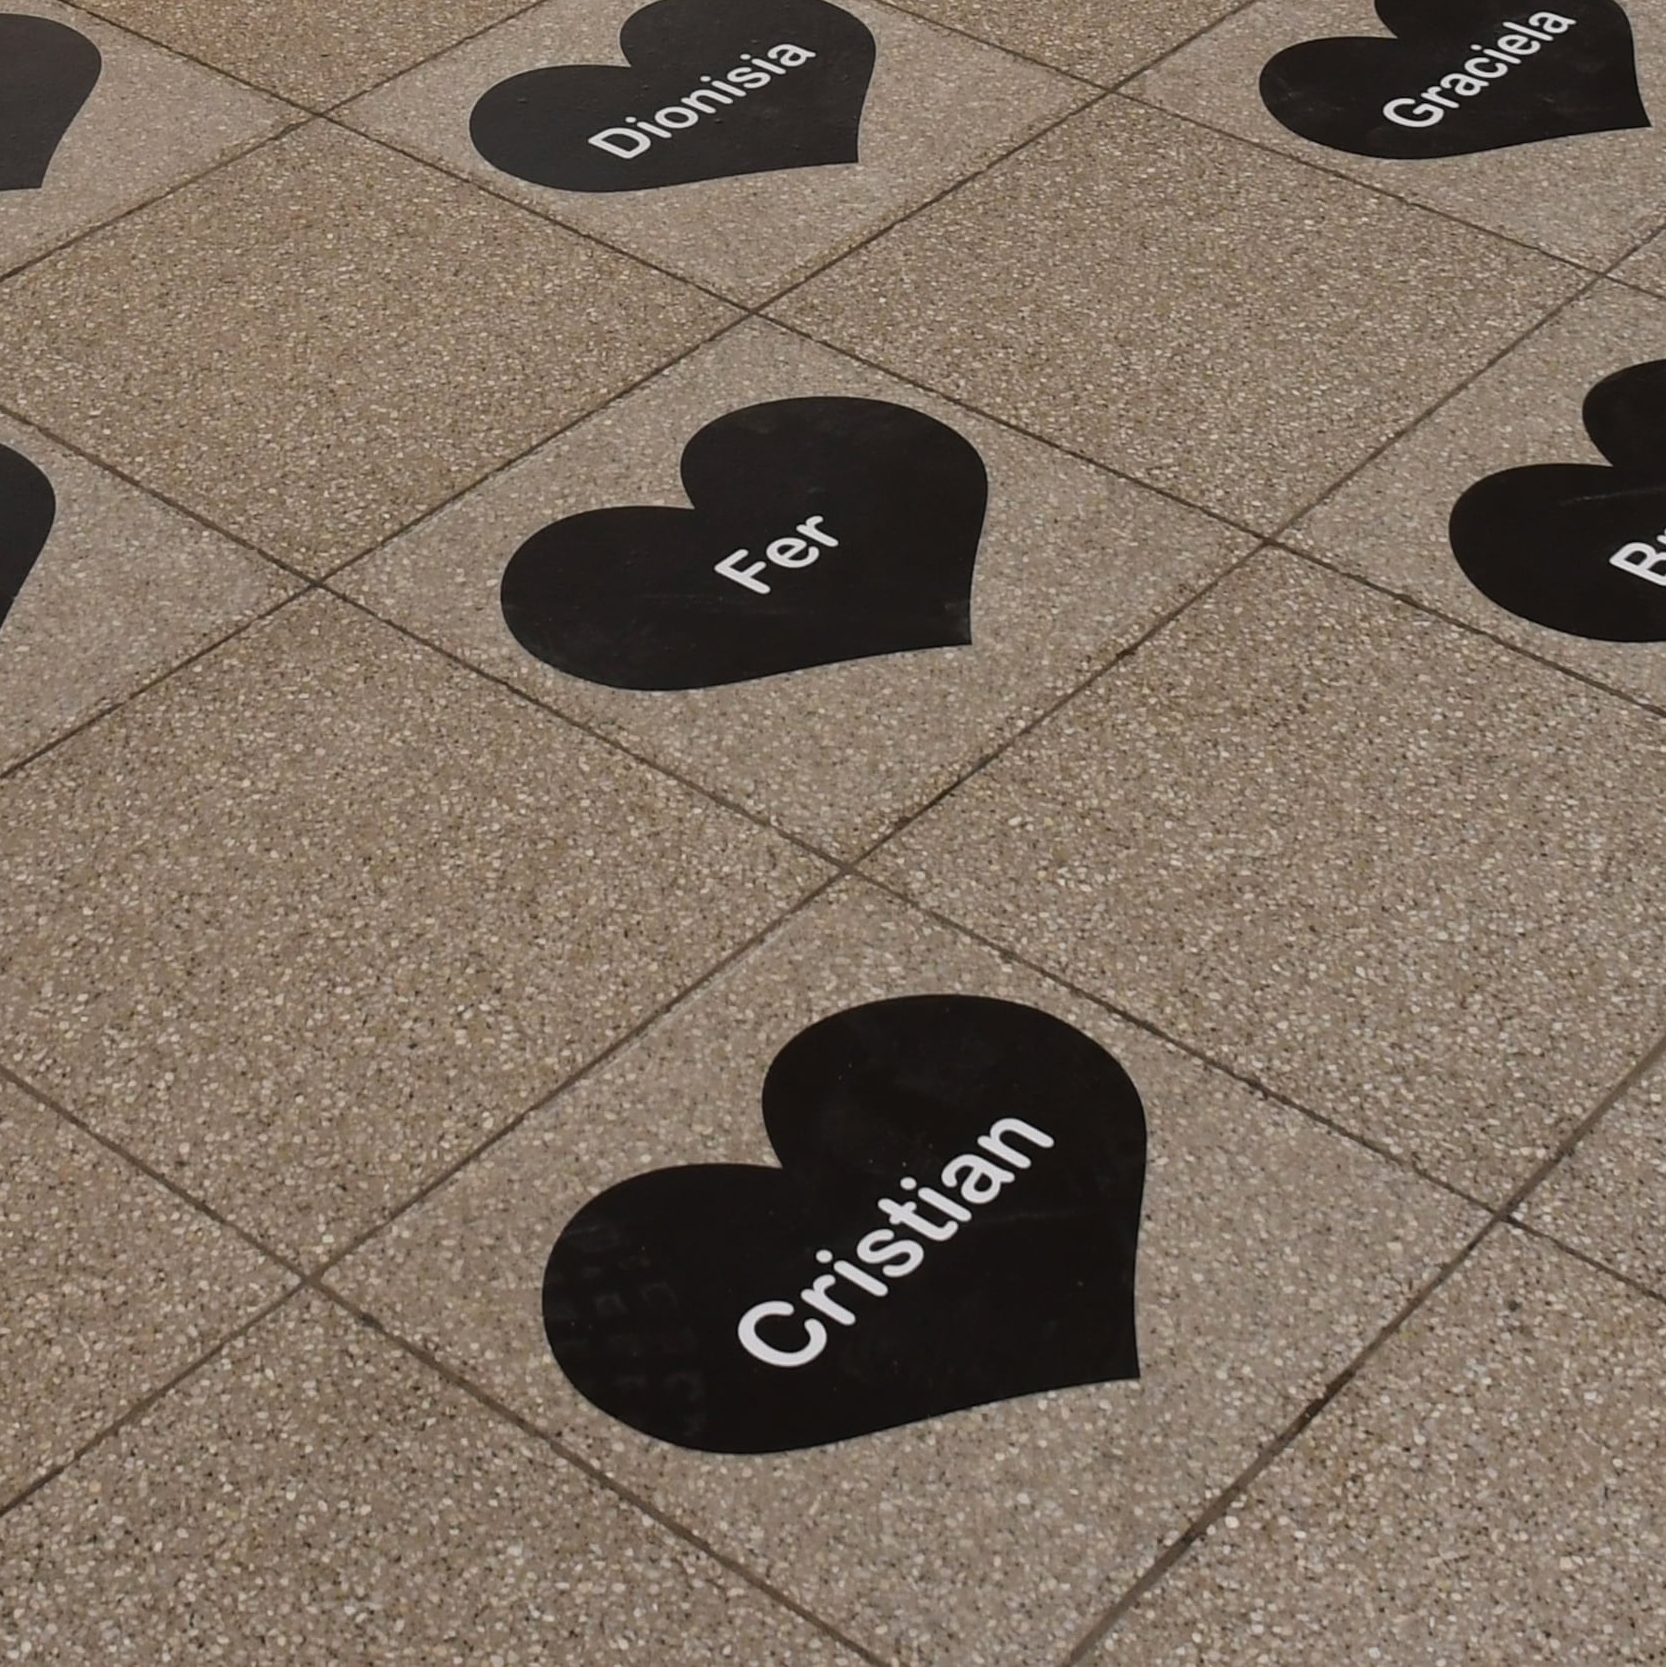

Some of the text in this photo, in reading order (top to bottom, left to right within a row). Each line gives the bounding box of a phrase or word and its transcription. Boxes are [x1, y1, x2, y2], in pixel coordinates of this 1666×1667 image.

[586, 40, 817, 161] Dionisia
[1381, 8, 1578, 130] Graciela
[713, 513, 840, 596] Fer
[736, 1112, 1055, 1371] Cristian
